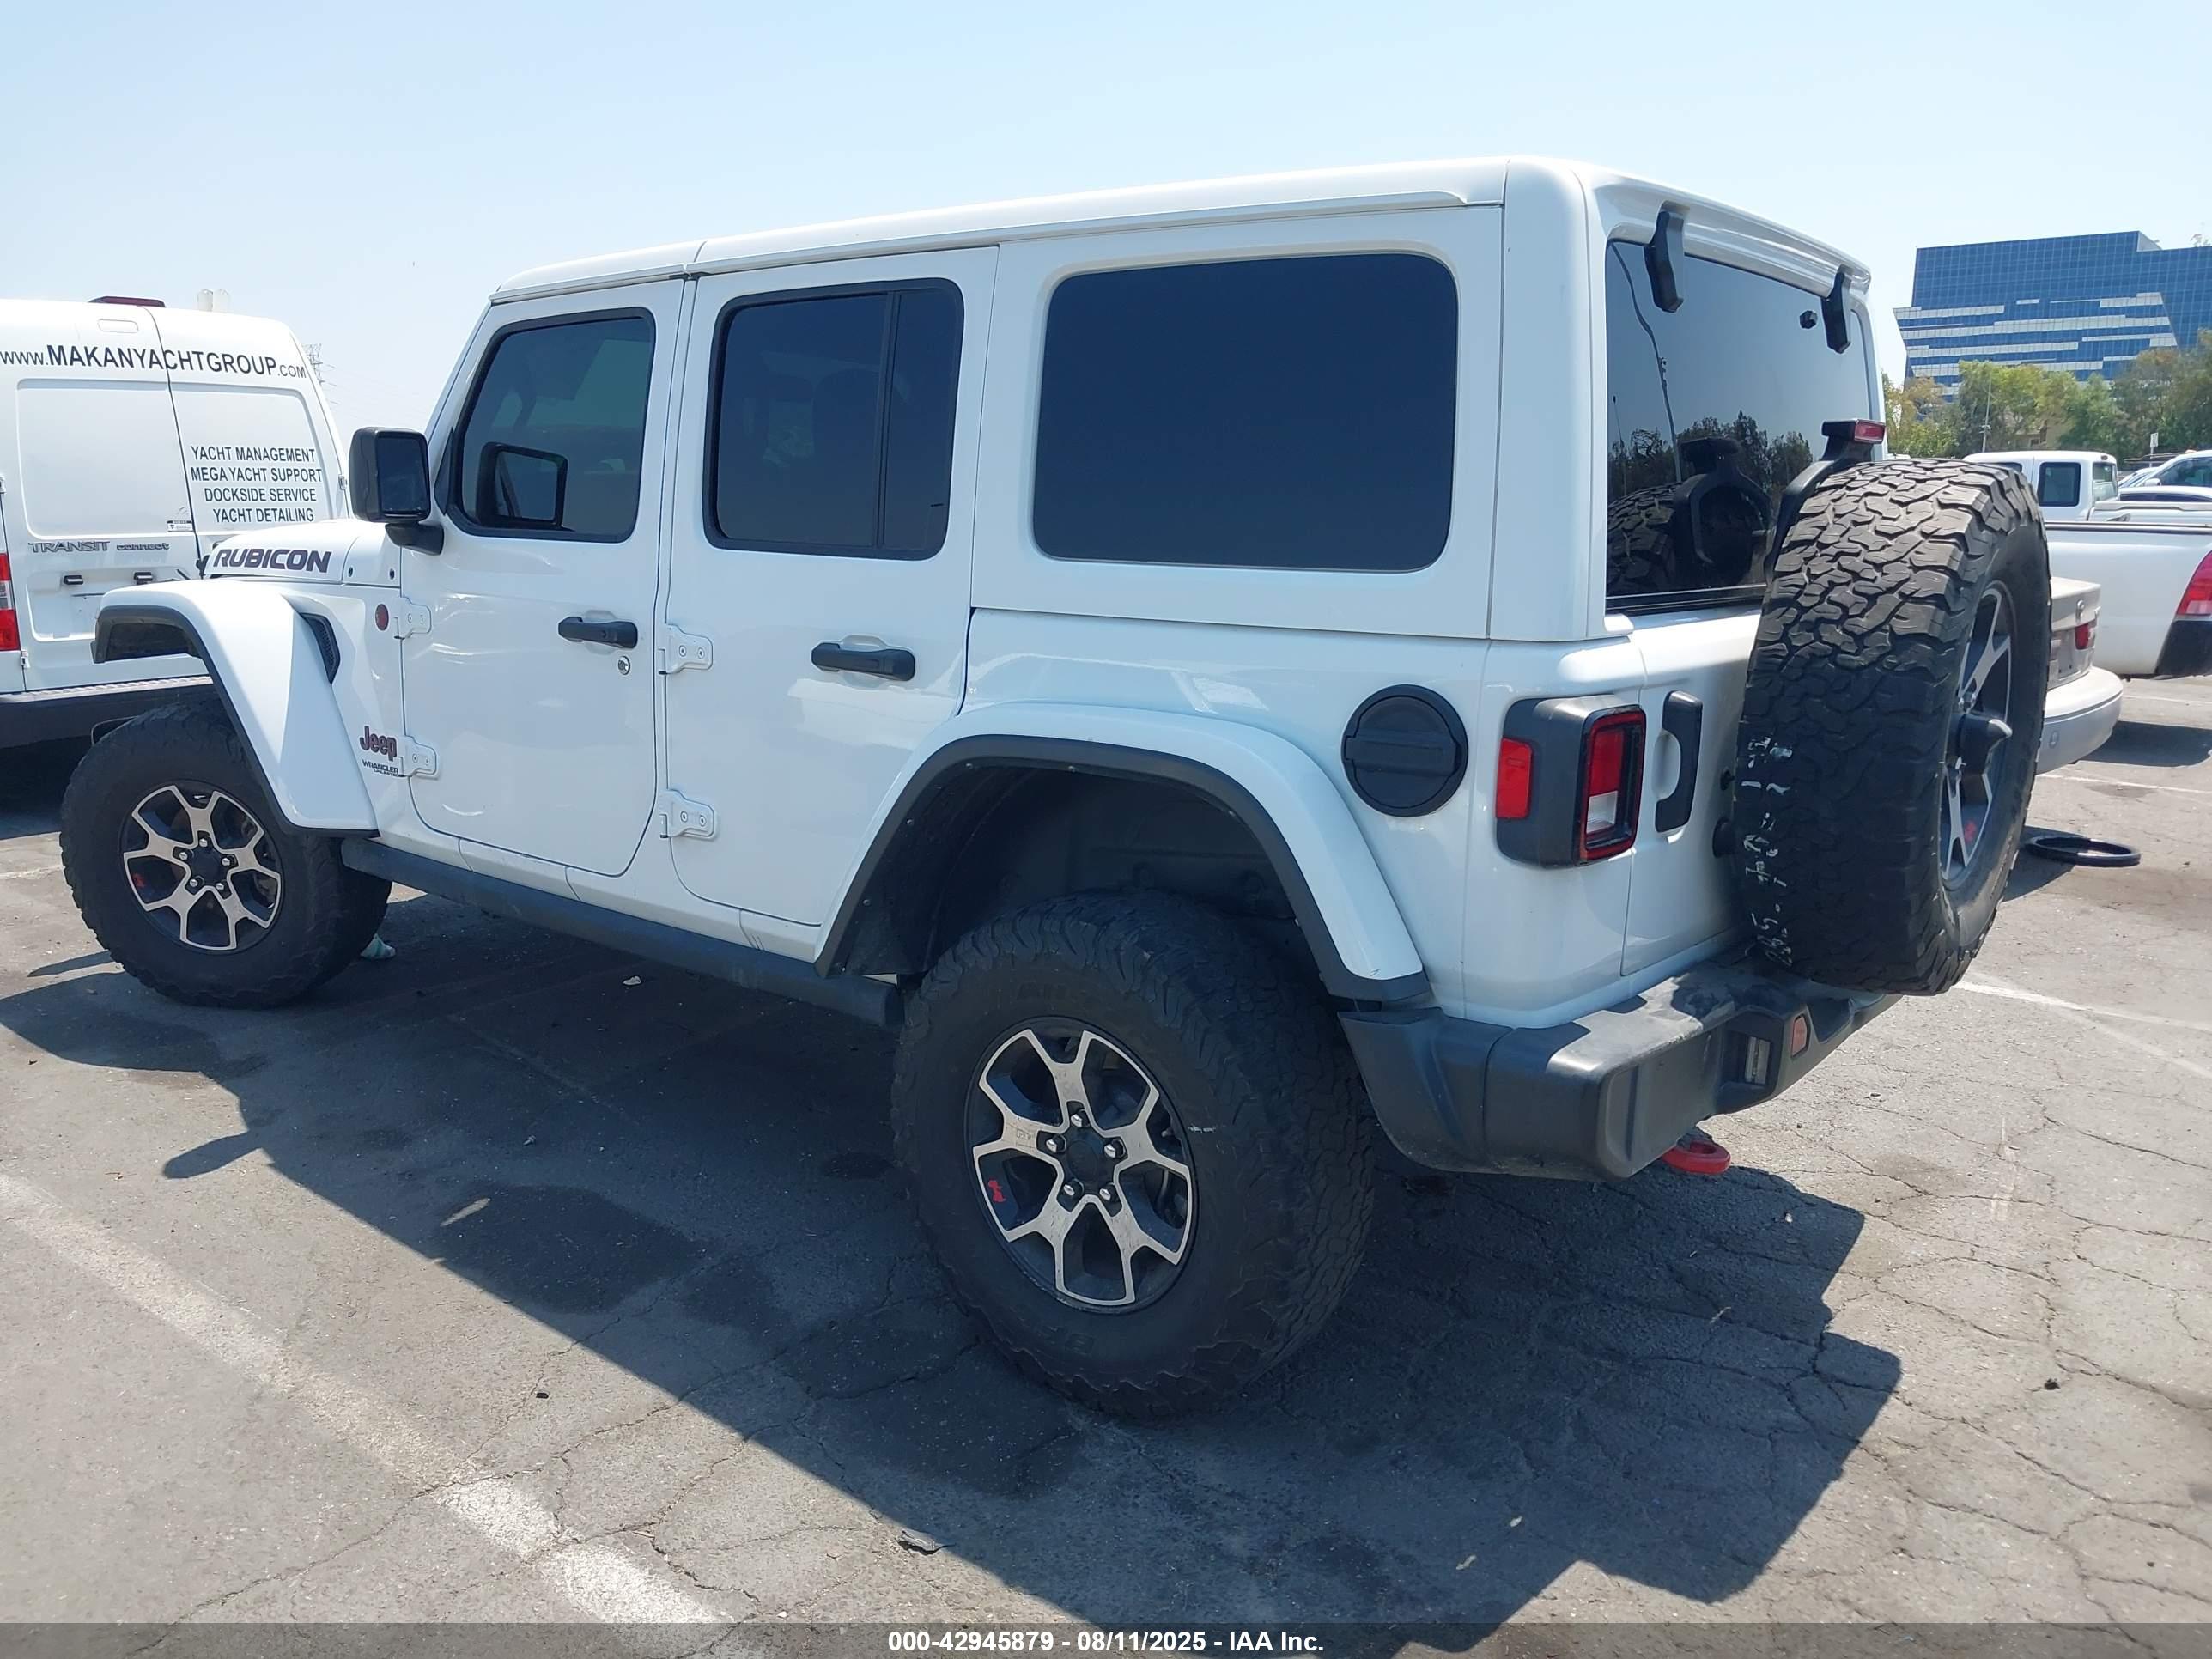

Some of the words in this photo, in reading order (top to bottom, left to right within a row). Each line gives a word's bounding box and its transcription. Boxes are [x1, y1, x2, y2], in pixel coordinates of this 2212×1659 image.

[191, 446, 232, 461] YACHT
[235, 447, 315, 462] MANAGEMENT
[191, 466, 228, 482] MEGA
[228, 467, 268, 482] YACHT
[271, 468, 322, 482] SUPPORT
[204, 488, 267, 502] DOCKSIDE
[270, 488, 317, 502] SERVICE
[213, 508, 252, 523] YACHT
[256, 508, 314, 523] DETAILING
[28, 541, 111, 553] TRANSIT
[213, 548, 332, 574] RUBICON
[359, 726, 398, 762] Jeep
[362, 759, 399, 775] WRANGLER
